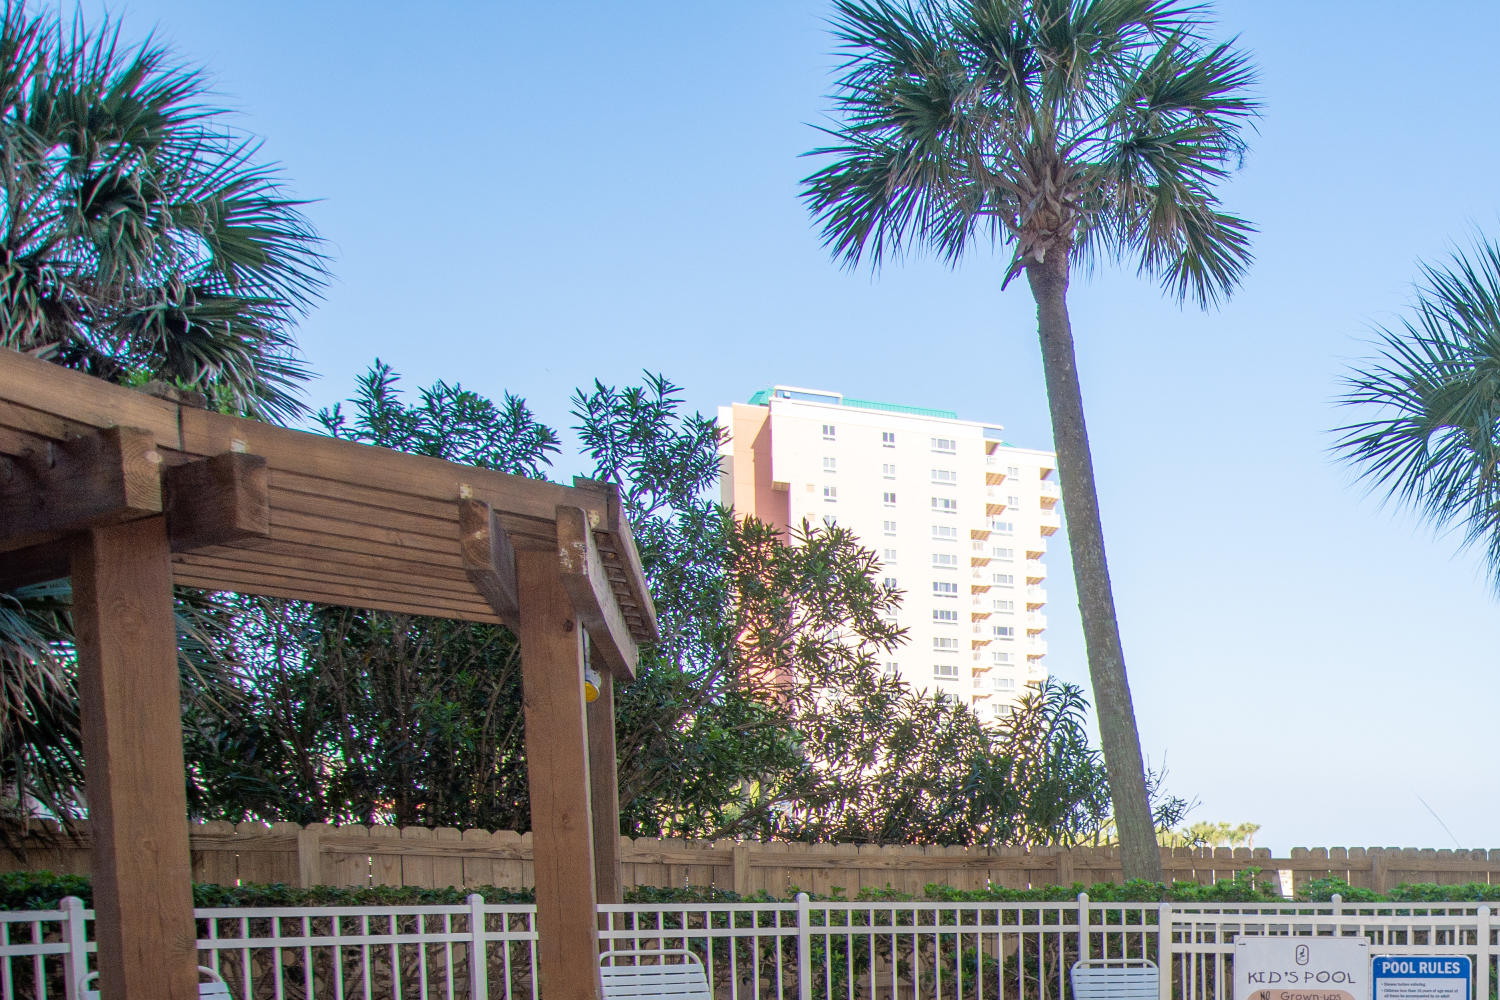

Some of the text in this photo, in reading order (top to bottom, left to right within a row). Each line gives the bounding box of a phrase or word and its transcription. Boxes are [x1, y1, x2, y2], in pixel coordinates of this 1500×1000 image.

[1382, 961, 1461, 974] POOL RULES
[1248, 970, 1356, 984] KID'S POOL
